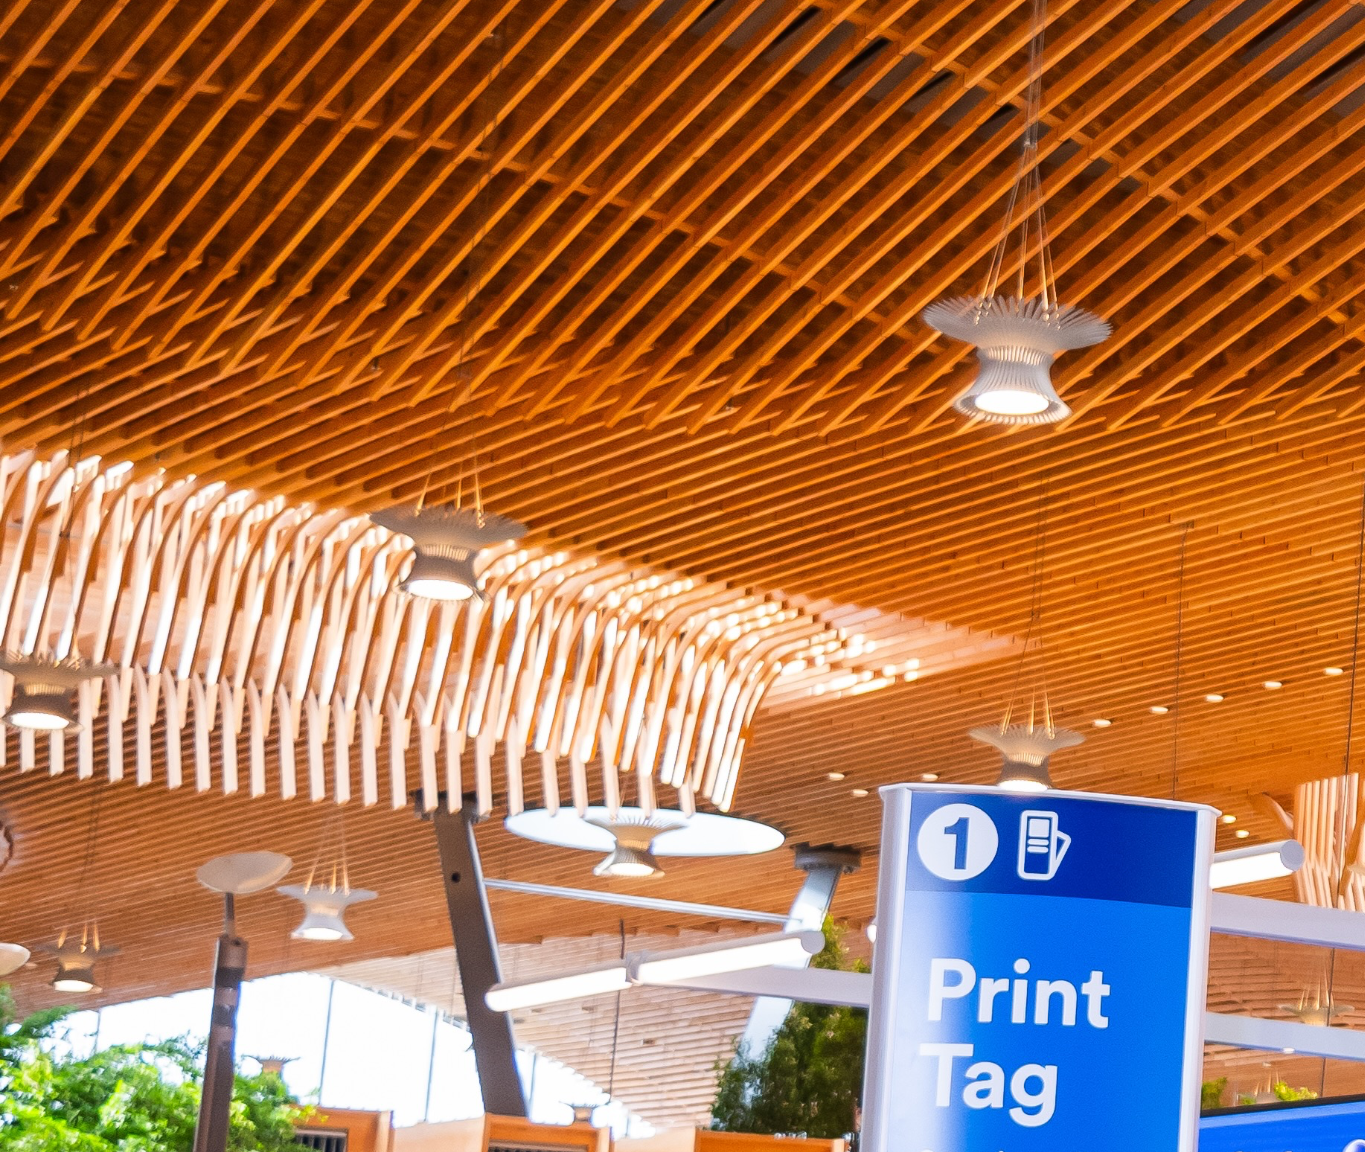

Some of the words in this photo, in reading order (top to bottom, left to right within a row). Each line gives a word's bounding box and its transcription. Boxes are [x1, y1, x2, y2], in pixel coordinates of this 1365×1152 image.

[943, 815, 971, 871] 1
[926, 957, 1111, 1029] Print
[918, 1043, 1058, 1128] Tag
